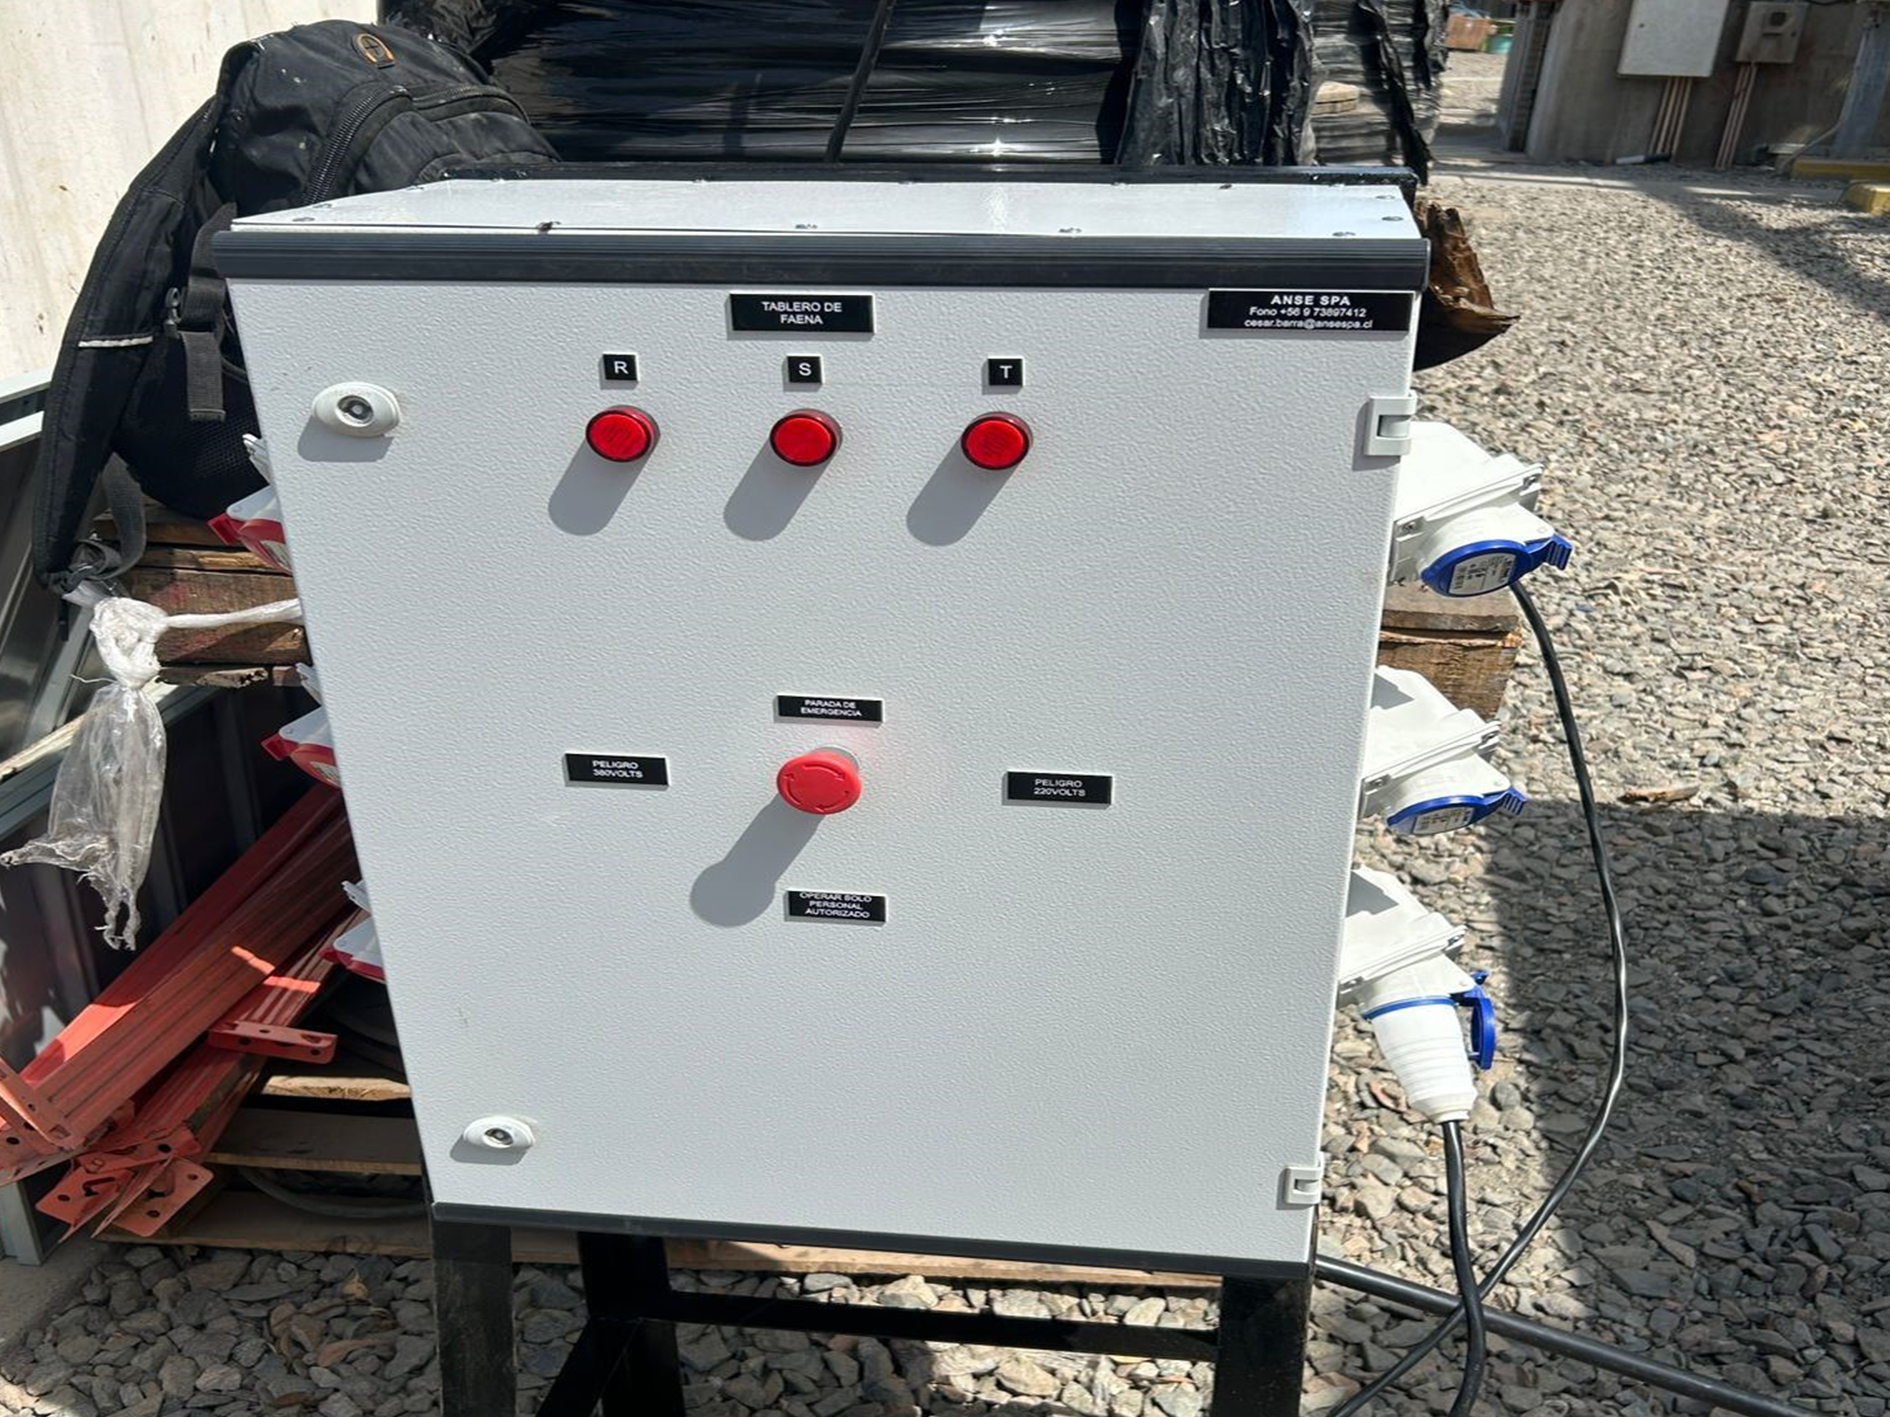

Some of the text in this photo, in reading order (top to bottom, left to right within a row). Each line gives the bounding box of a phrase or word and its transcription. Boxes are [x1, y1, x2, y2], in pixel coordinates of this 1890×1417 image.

[1270, 295, 1351, 306] ANSE SPA
[762, 301, 842, 312] TABLERO DE
[1249, 307, 1277, 316] Fono
[1303, 308, 1310, 317] 9
[780, 314, 823, 324] FAENA
[614, 361, 628, 374] R
[798, 362, 812, 376] S
[1000, 365, 1013, 379] T
[805, 700, 857, 709] PARADA DE
[801, 707, 862, 716] EMERGENCIA
[592, 760, 639, 769] PELIGRO
[593, 769, 643, 778] 380VOLTS
[1035, 779, 1082, 787] PELIGRO
[1034, 788, 1086, 796] 220VOLTS
[799, 892, 842, 901] OPERAR
[809, 900, 863, 910] PERSONAL
[805, 908, 870, 918] AUTORIZADO
